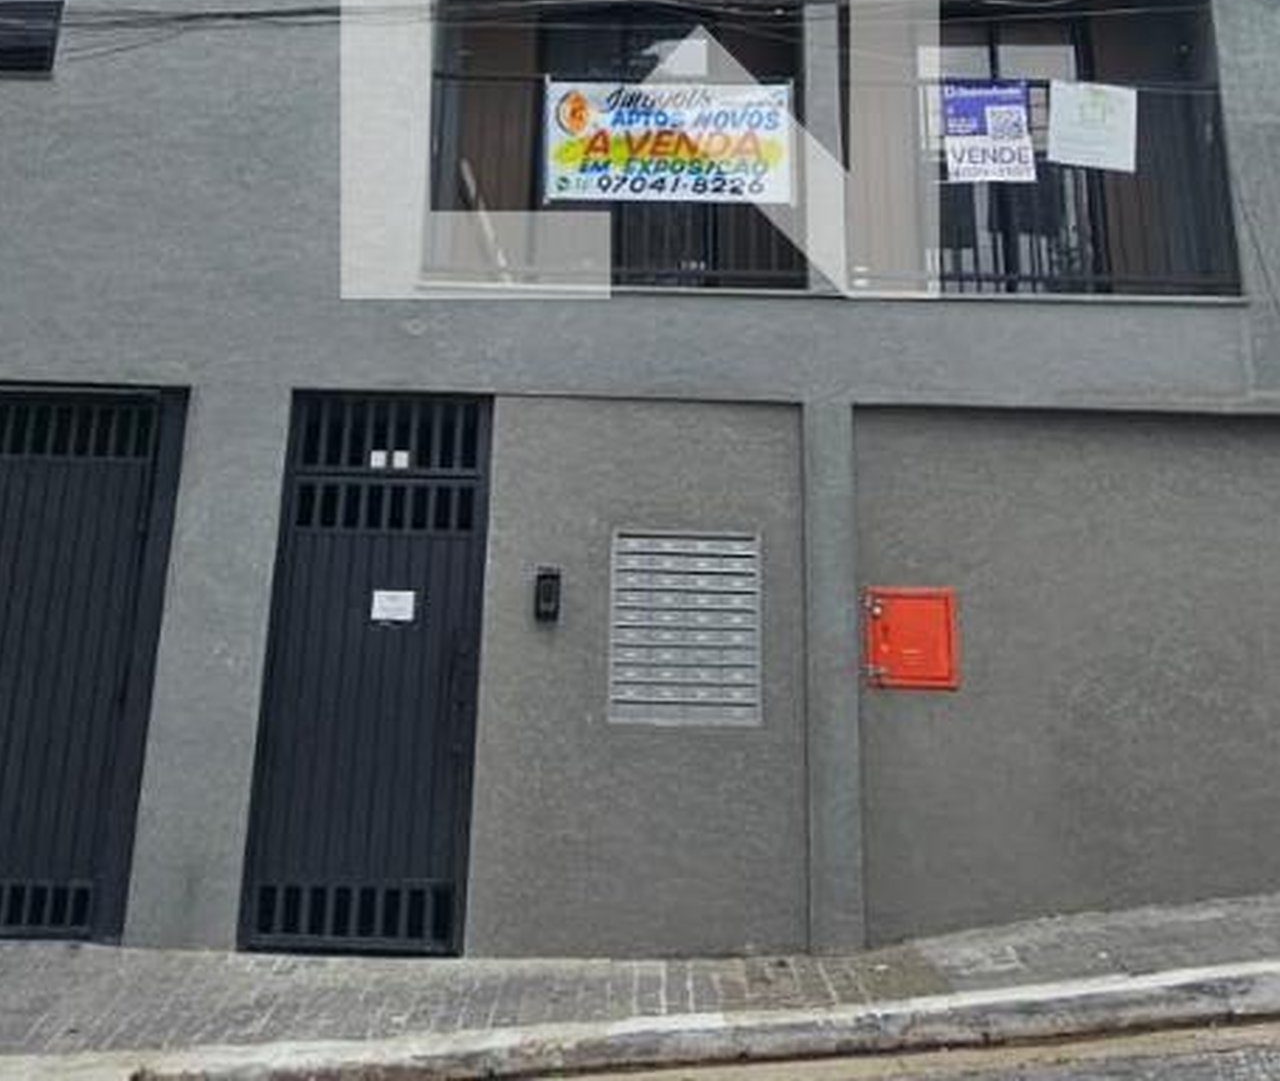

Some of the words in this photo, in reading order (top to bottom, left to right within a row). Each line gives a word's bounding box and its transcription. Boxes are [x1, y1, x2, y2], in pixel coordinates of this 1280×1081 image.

[692, 109, 782, 131] NOVOS
[623, 129, 763, 159] VENDA
[950, 145, 1031, 164] VENDE
[597, 175, 766, 196] 97041-8226
